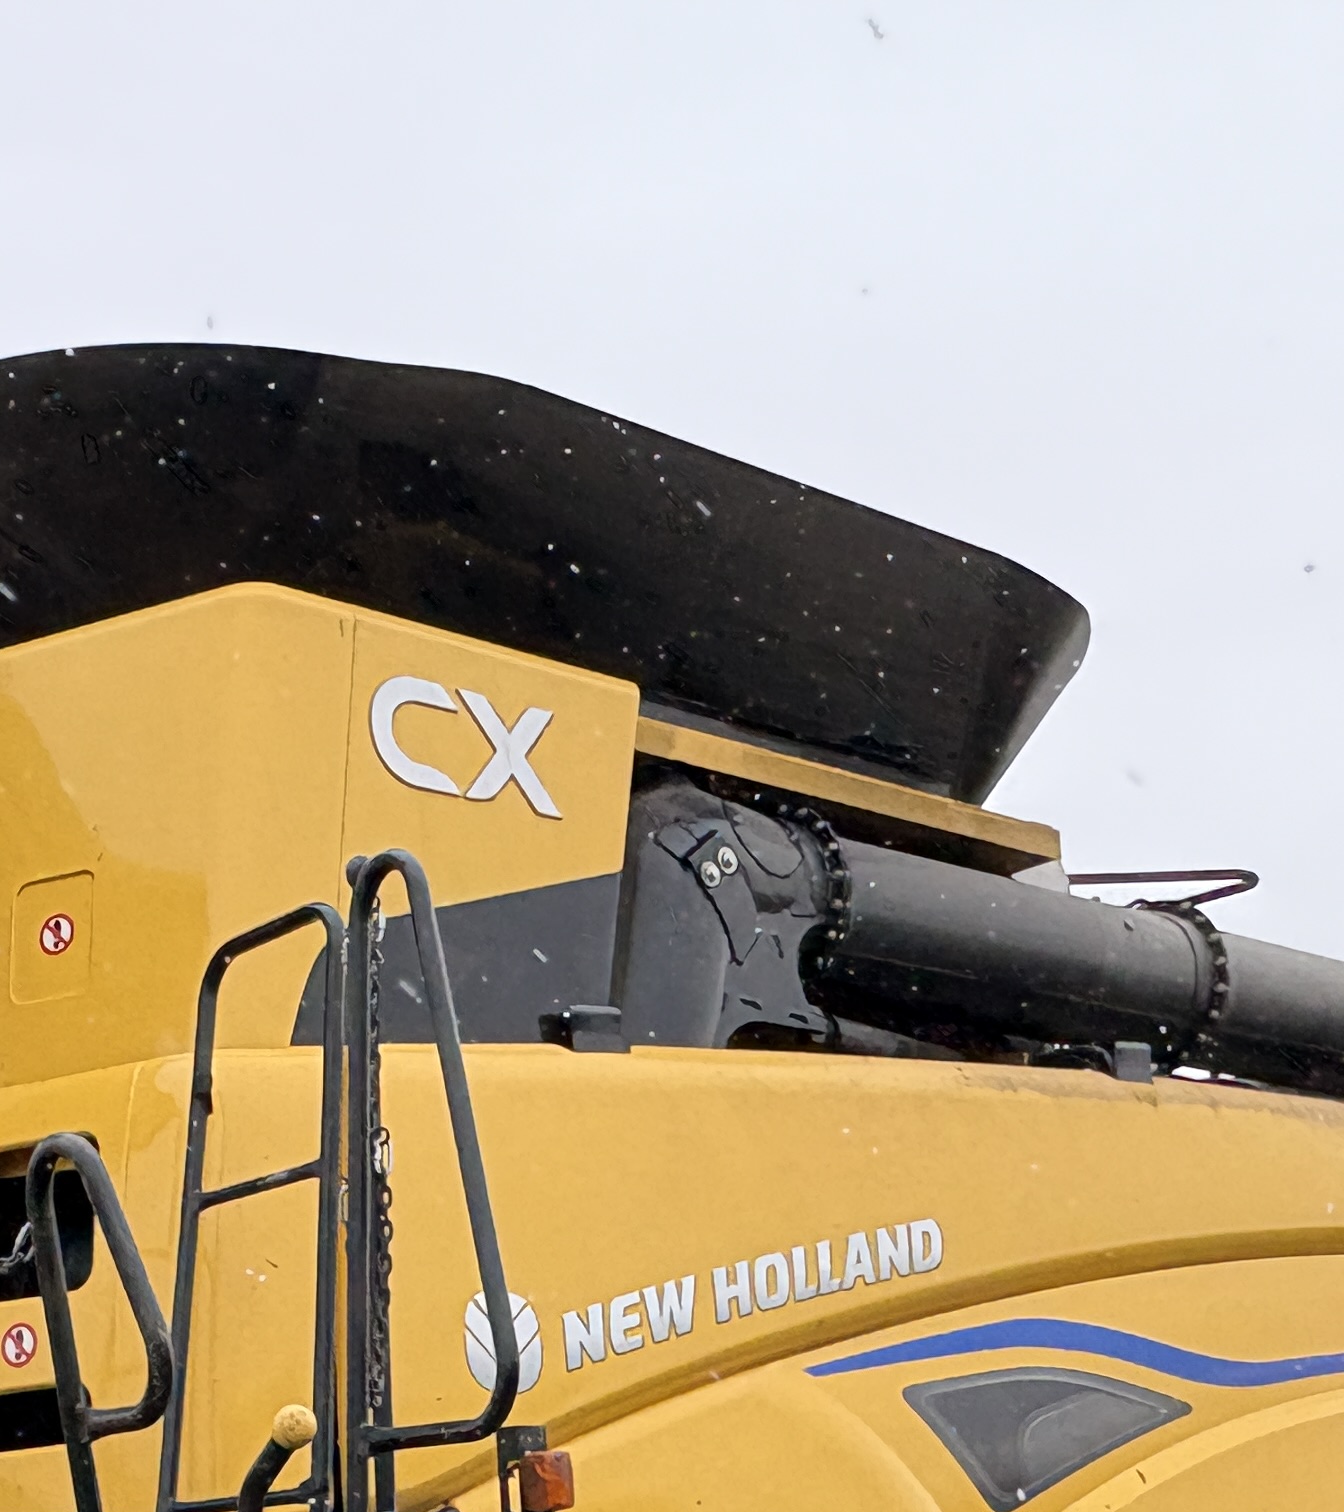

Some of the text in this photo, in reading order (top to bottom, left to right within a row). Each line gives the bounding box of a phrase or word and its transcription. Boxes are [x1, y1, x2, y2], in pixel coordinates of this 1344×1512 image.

[369, 676, 563, 820] CX
[561, 1218, 944, 1372] NEW HOLLAND
